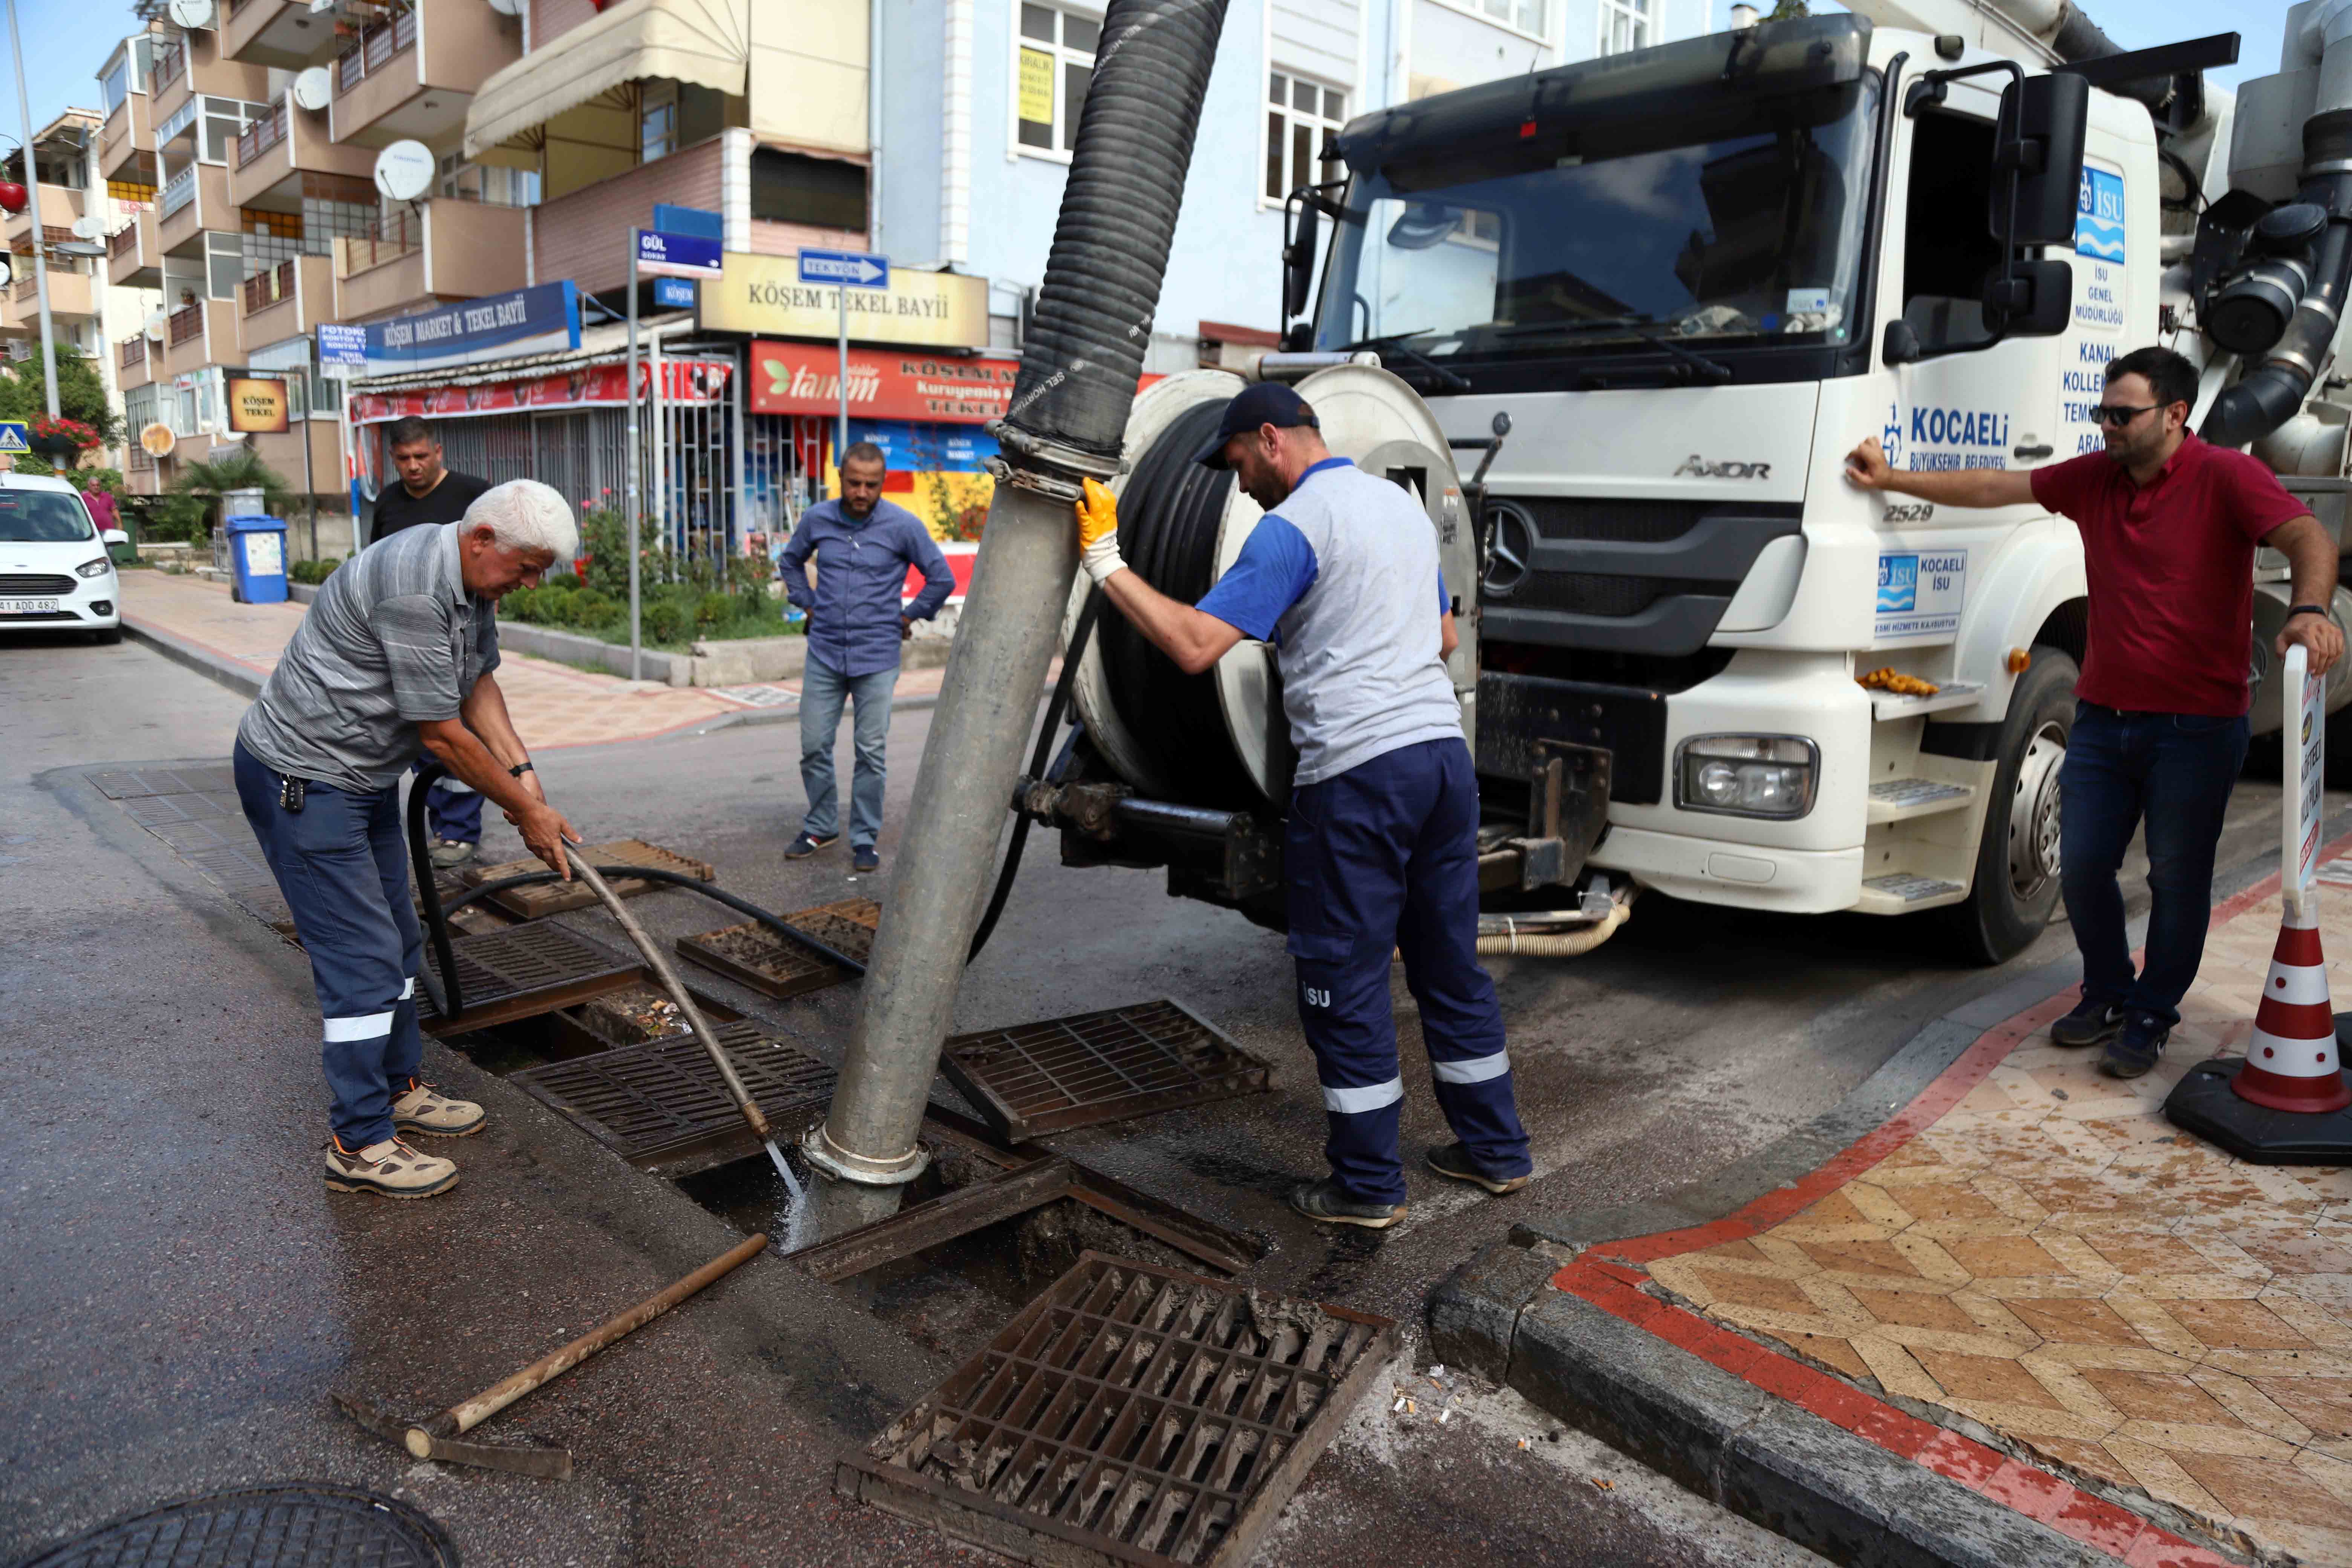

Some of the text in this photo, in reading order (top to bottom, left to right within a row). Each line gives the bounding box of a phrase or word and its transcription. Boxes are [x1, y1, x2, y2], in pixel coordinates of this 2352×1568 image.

[2097, 182, 2122, 220] İSU
[642, 234, 666, 251] GÜL
[642, 251, 666, 261] SOKAK
[808, 261, 859, 274] TEK YÖN
[2095, 264, 2107, 282] İSU
[749, 280, 821, 311] KÖŞEM
[828, 291, 892, 314] TEKEL
[2089, 286, 2113, 303] GENEL
[2076, 305, 2123, 325] MÜDÜRLÜĞÜ
[383, 322, 413, 351] KÖŞEM
[415, 315, 452, 342] MARKET
[453, 311, 462, 335] &
[464, 306, 497, 333] TEKEL
[902, 360, 994, 382] KÖŞEM
[917, 380, 1001, 400] Kuruyemiş
[243, 395, 274, 406] KÖŞEM
[926, 398, 1005, 416] TEKEL
[2064, 397, 2099, 423] TEMİ
[1883, 504, 1934, 522] 2529
[1921, 555, 1964, 573] KOCAELİ
[1933, 574, 1950, 591] İSU
[0, 601, 57, 610] 41 ADD 482
